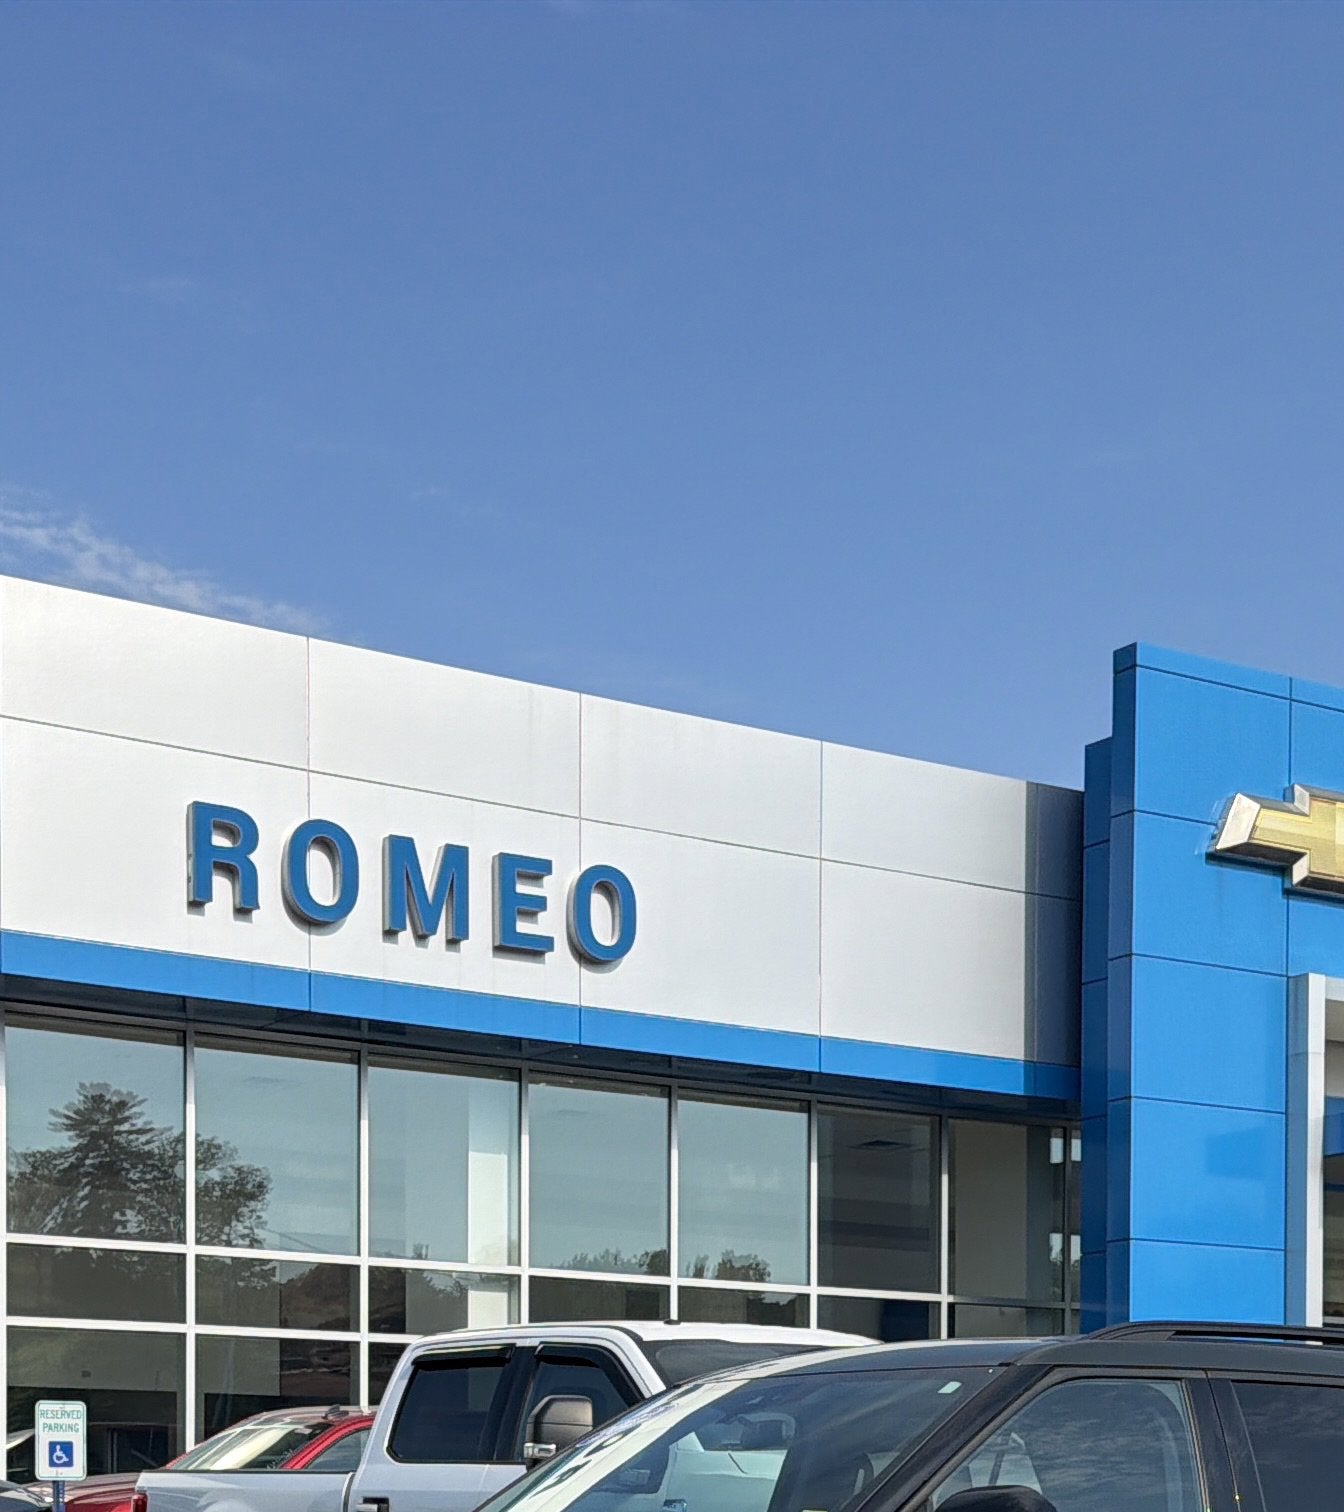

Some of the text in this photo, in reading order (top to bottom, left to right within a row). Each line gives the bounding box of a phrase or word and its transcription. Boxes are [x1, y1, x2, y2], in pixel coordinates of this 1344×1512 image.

[187, 800, 638, 964] ROMEO
[39, 1409, 82, 1420] RESERVED
[42, 1422, 80, 1433] PARKING
